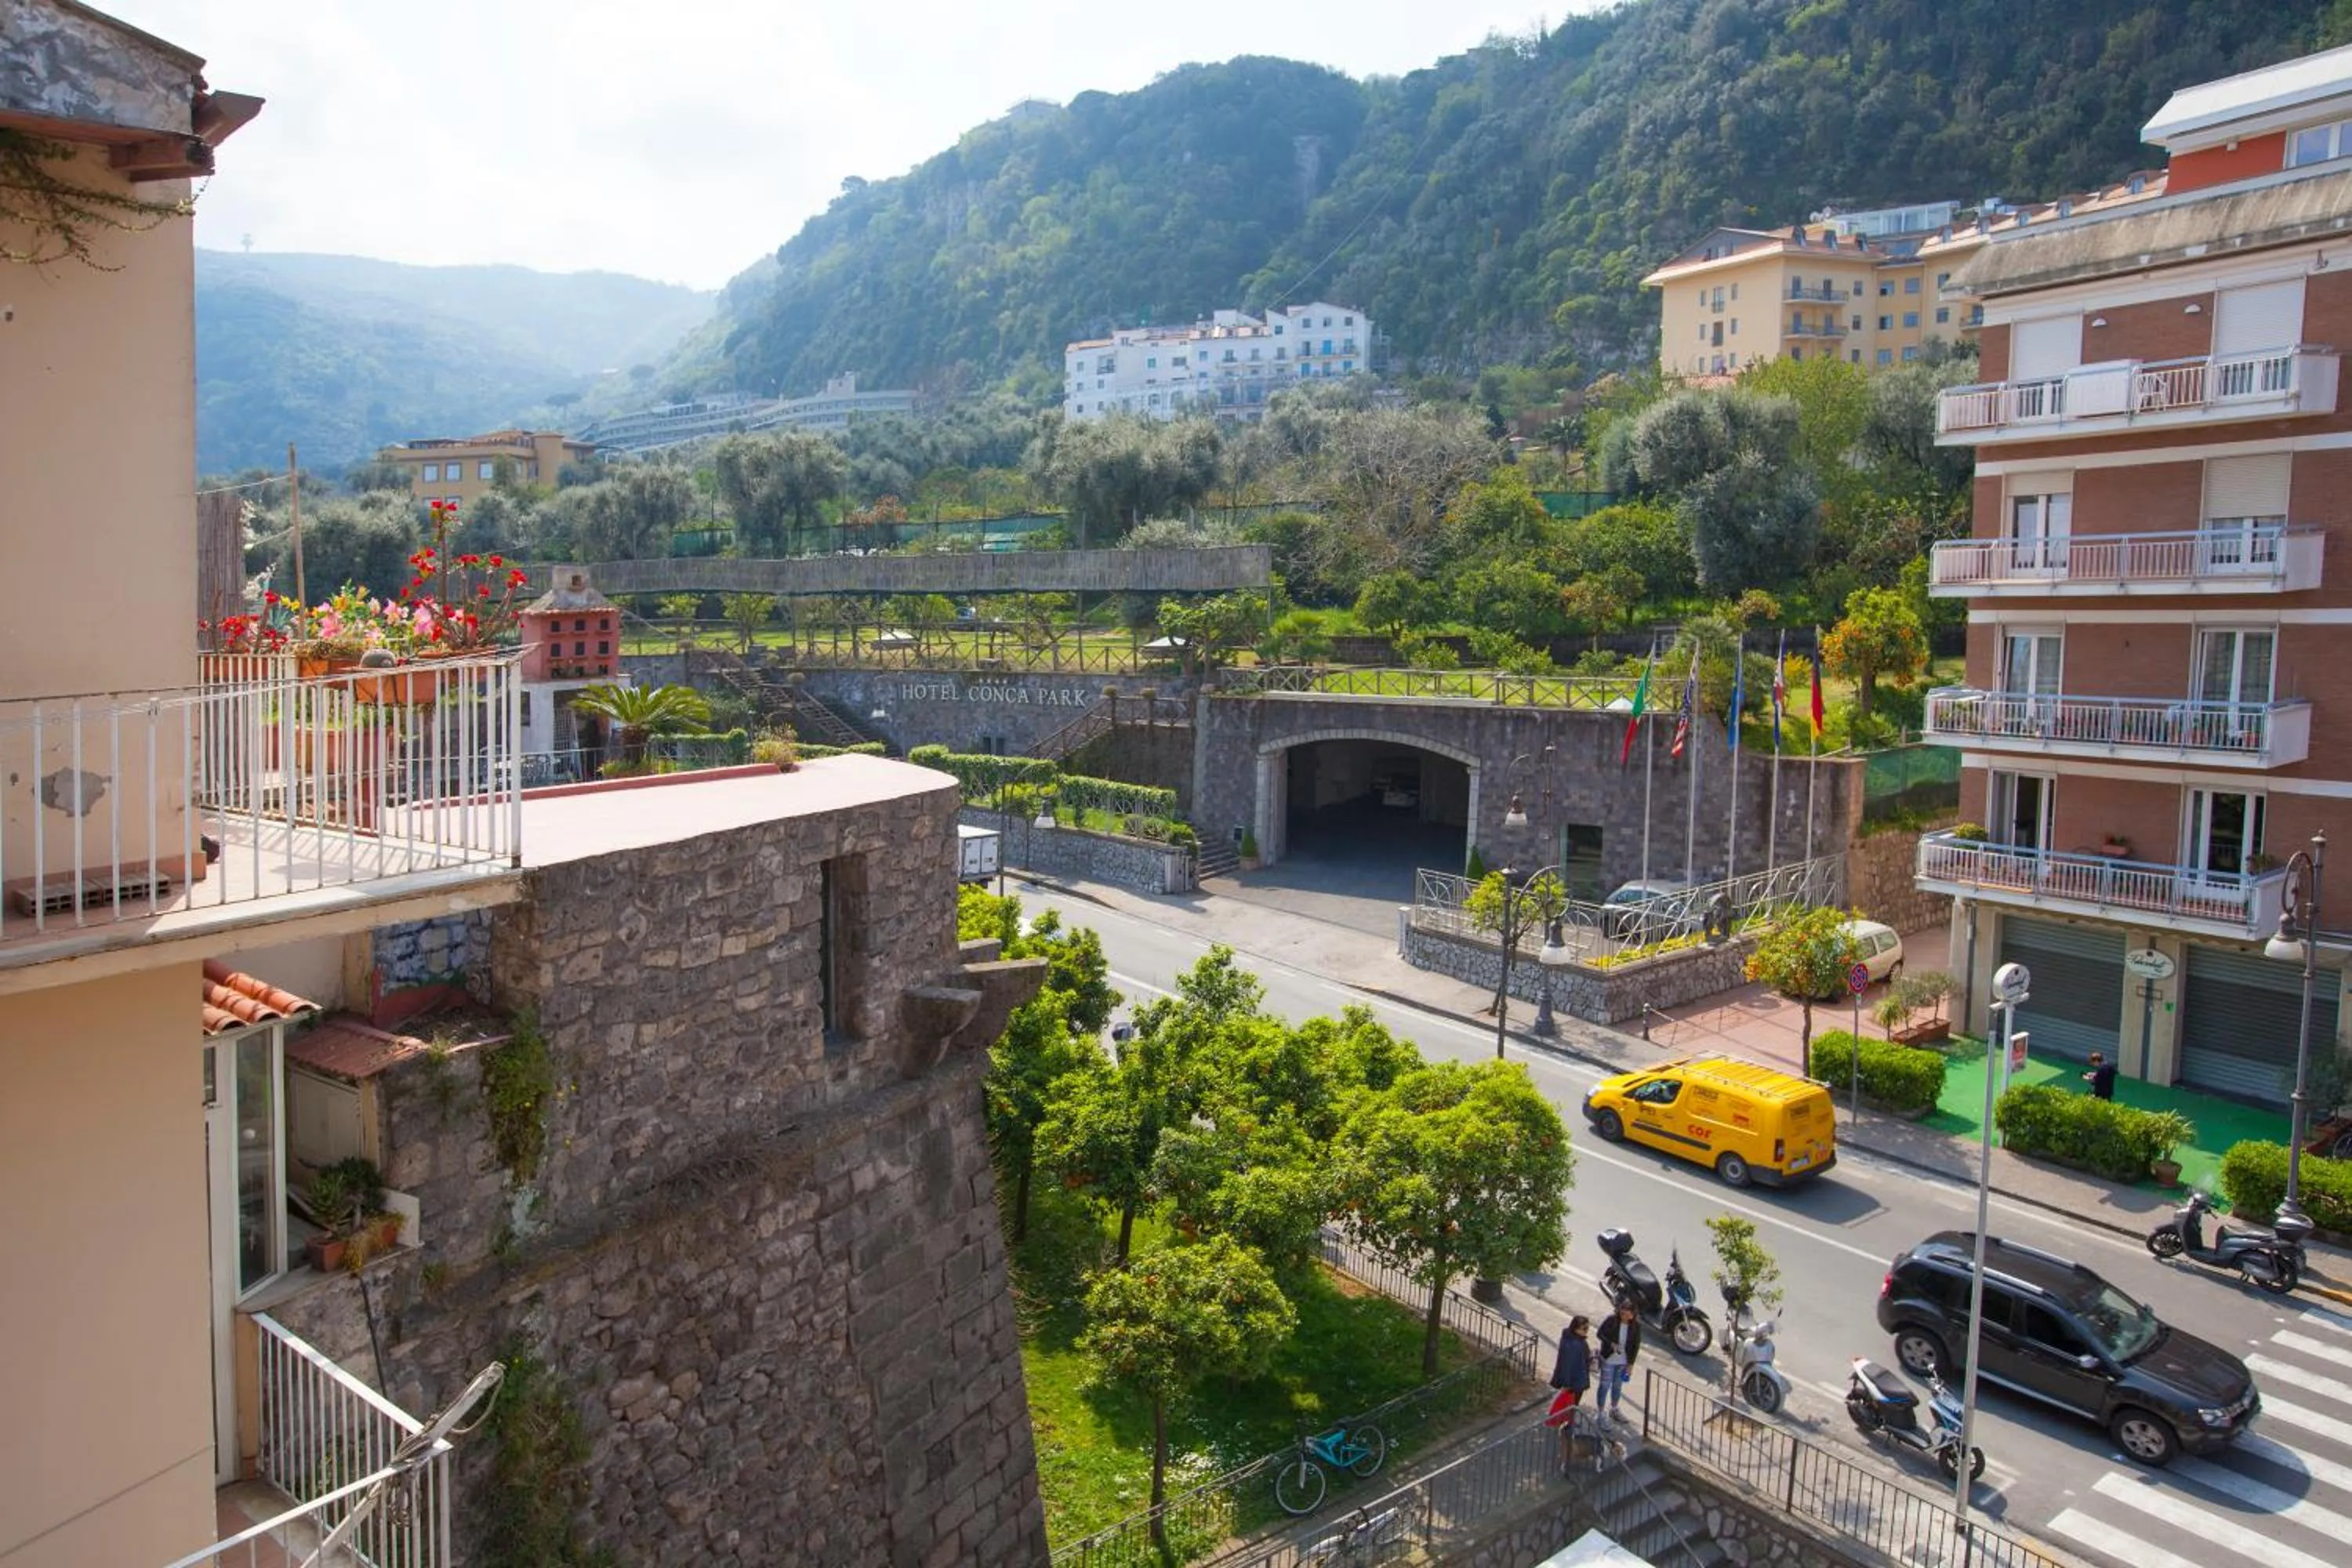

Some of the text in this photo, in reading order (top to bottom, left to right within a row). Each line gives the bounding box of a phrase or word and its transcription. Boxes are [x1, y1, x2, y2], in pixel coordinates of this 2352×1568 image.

[902, 684, 1087, 706] HOTEL CONCA PARK
